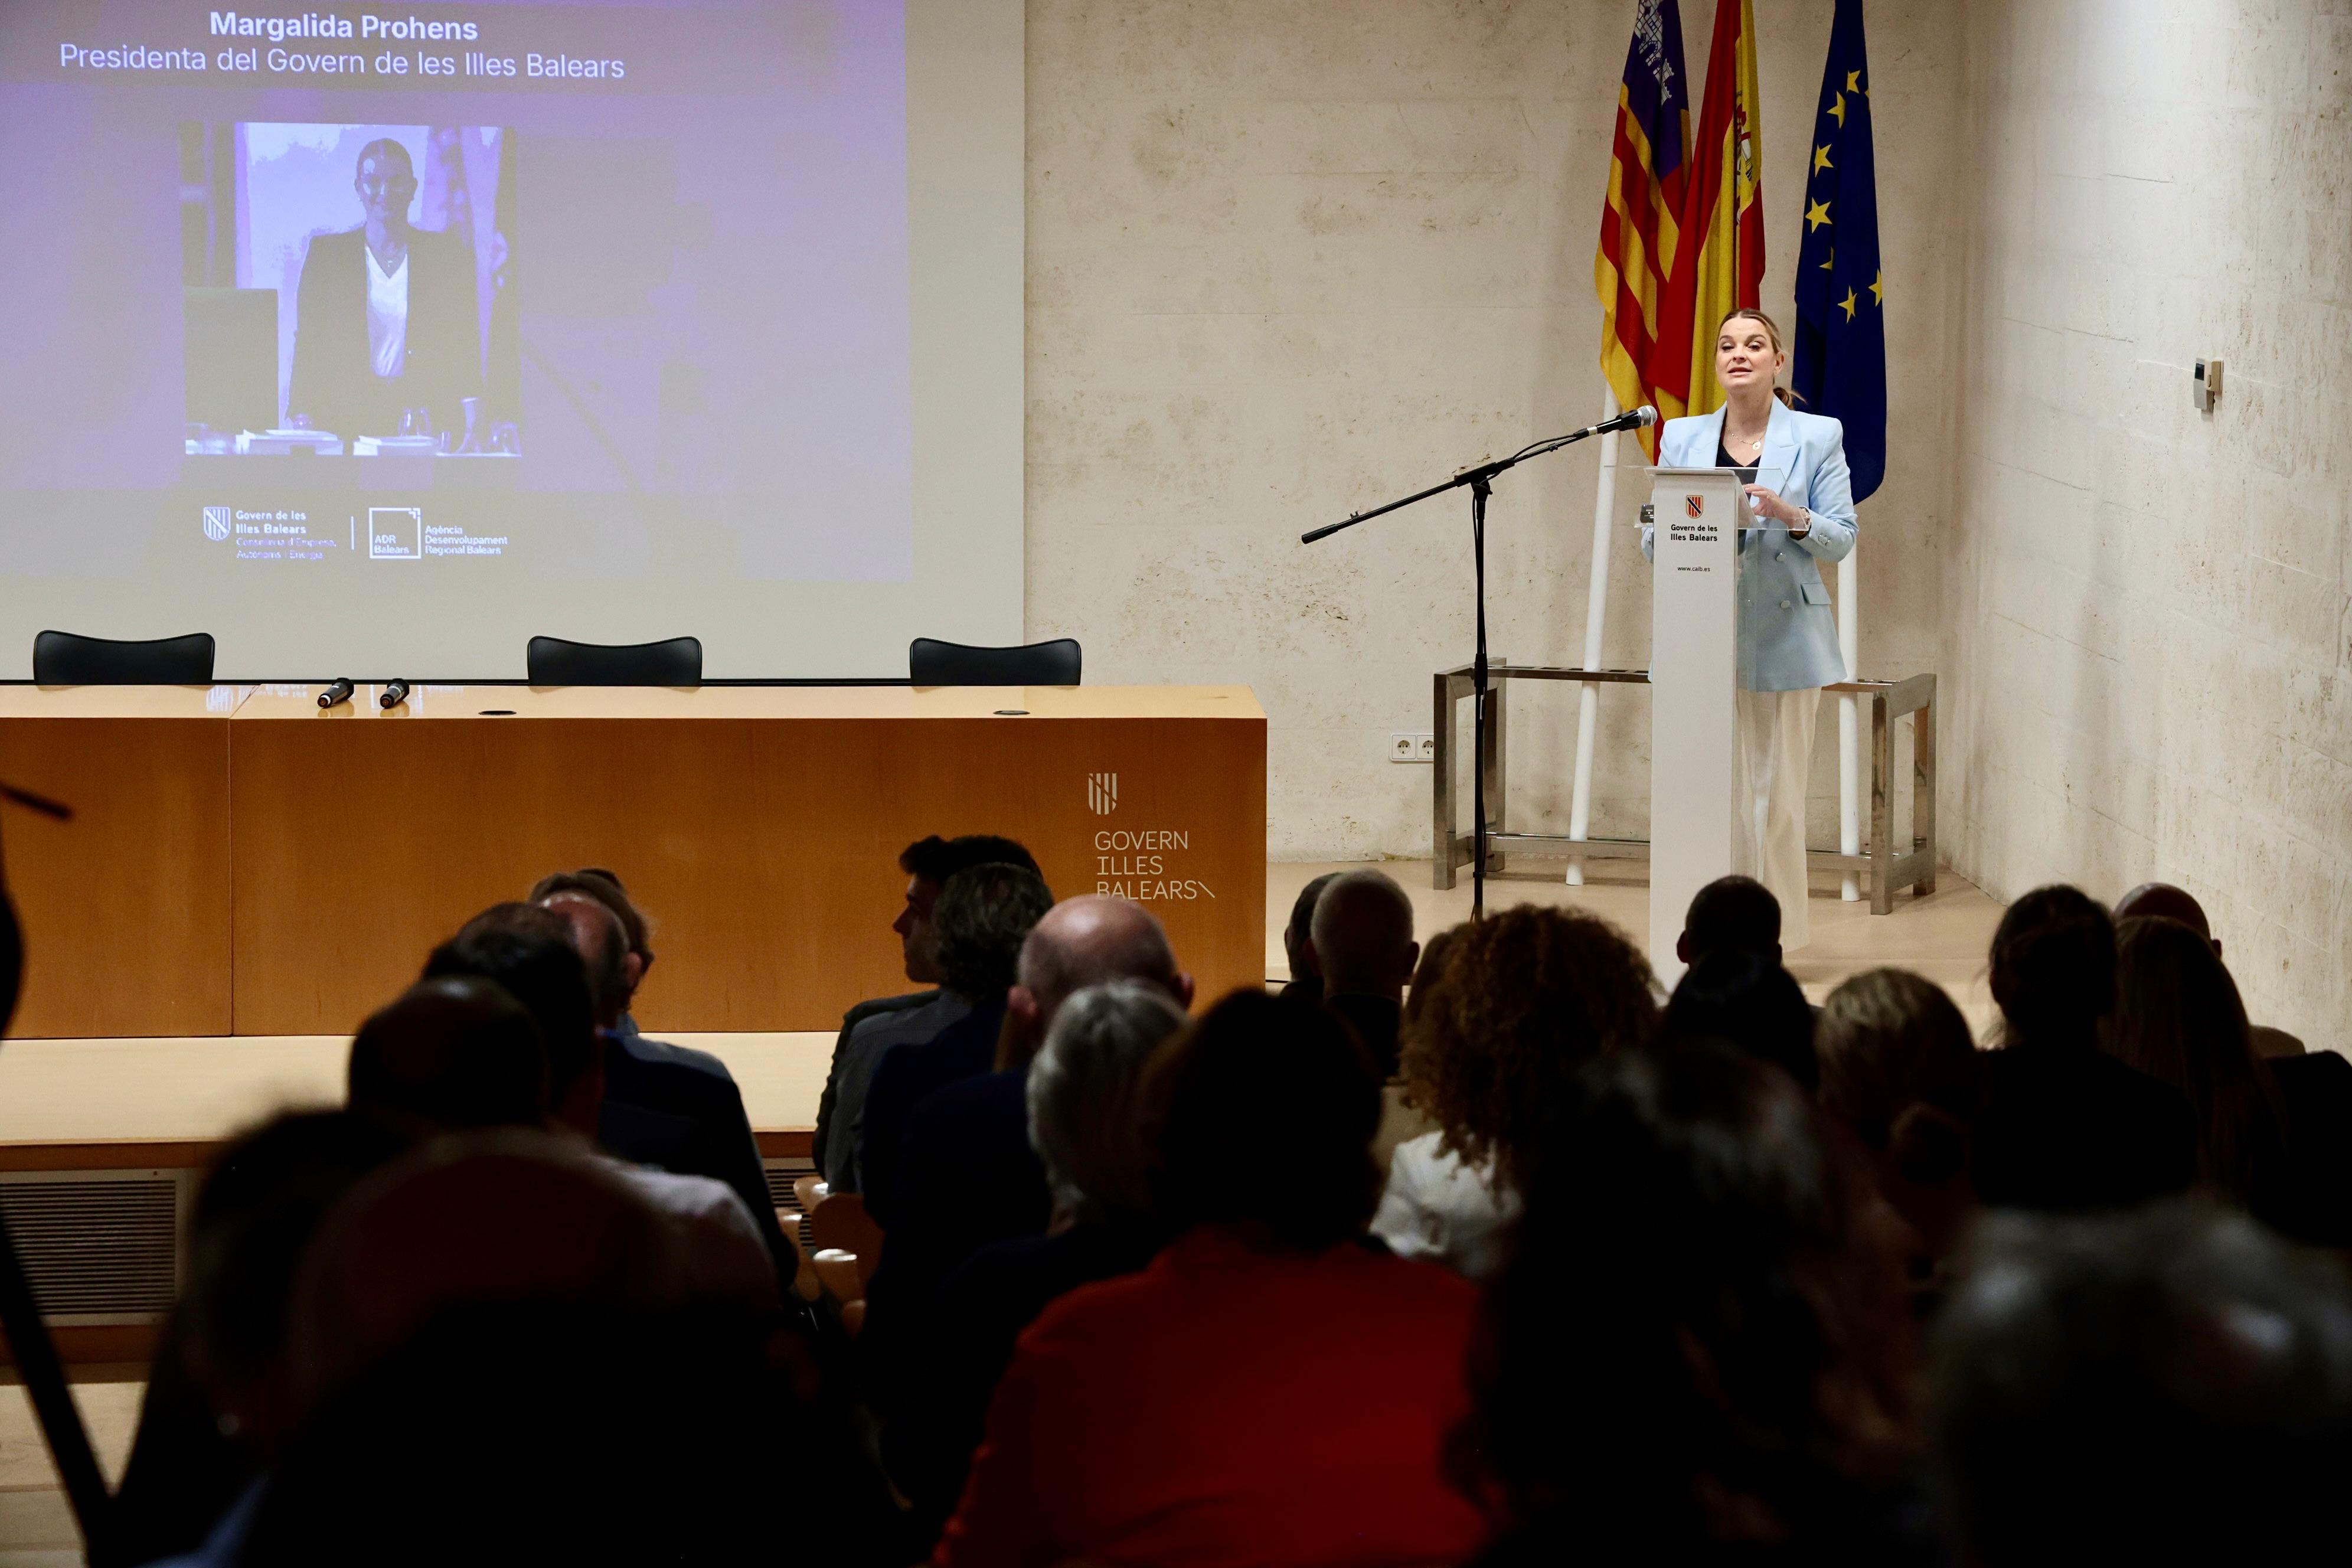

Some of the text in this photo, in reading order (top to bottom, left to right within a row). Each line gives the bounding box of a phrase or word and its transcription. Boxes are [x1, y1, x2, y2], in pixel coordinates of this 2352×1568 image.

[210, 11, 478, 42] Margalida Prohens
[60, 43, 625, 78] Presidenta del Govern de les Illes Balears
[236, 510, 306, 521] Govern de les
[236, 524, 306, 534] Illes Balears
[374, 534, 397, 544] ADR
[425, 535, 508, 547] Desenvolupament
[374, 545, 409, 554] Balears
[425, 545, 502, 556] Regional Balears
[1095, 831, 1188, 851] GOVERN
[1096, 855, 1163, 875] ILLES
